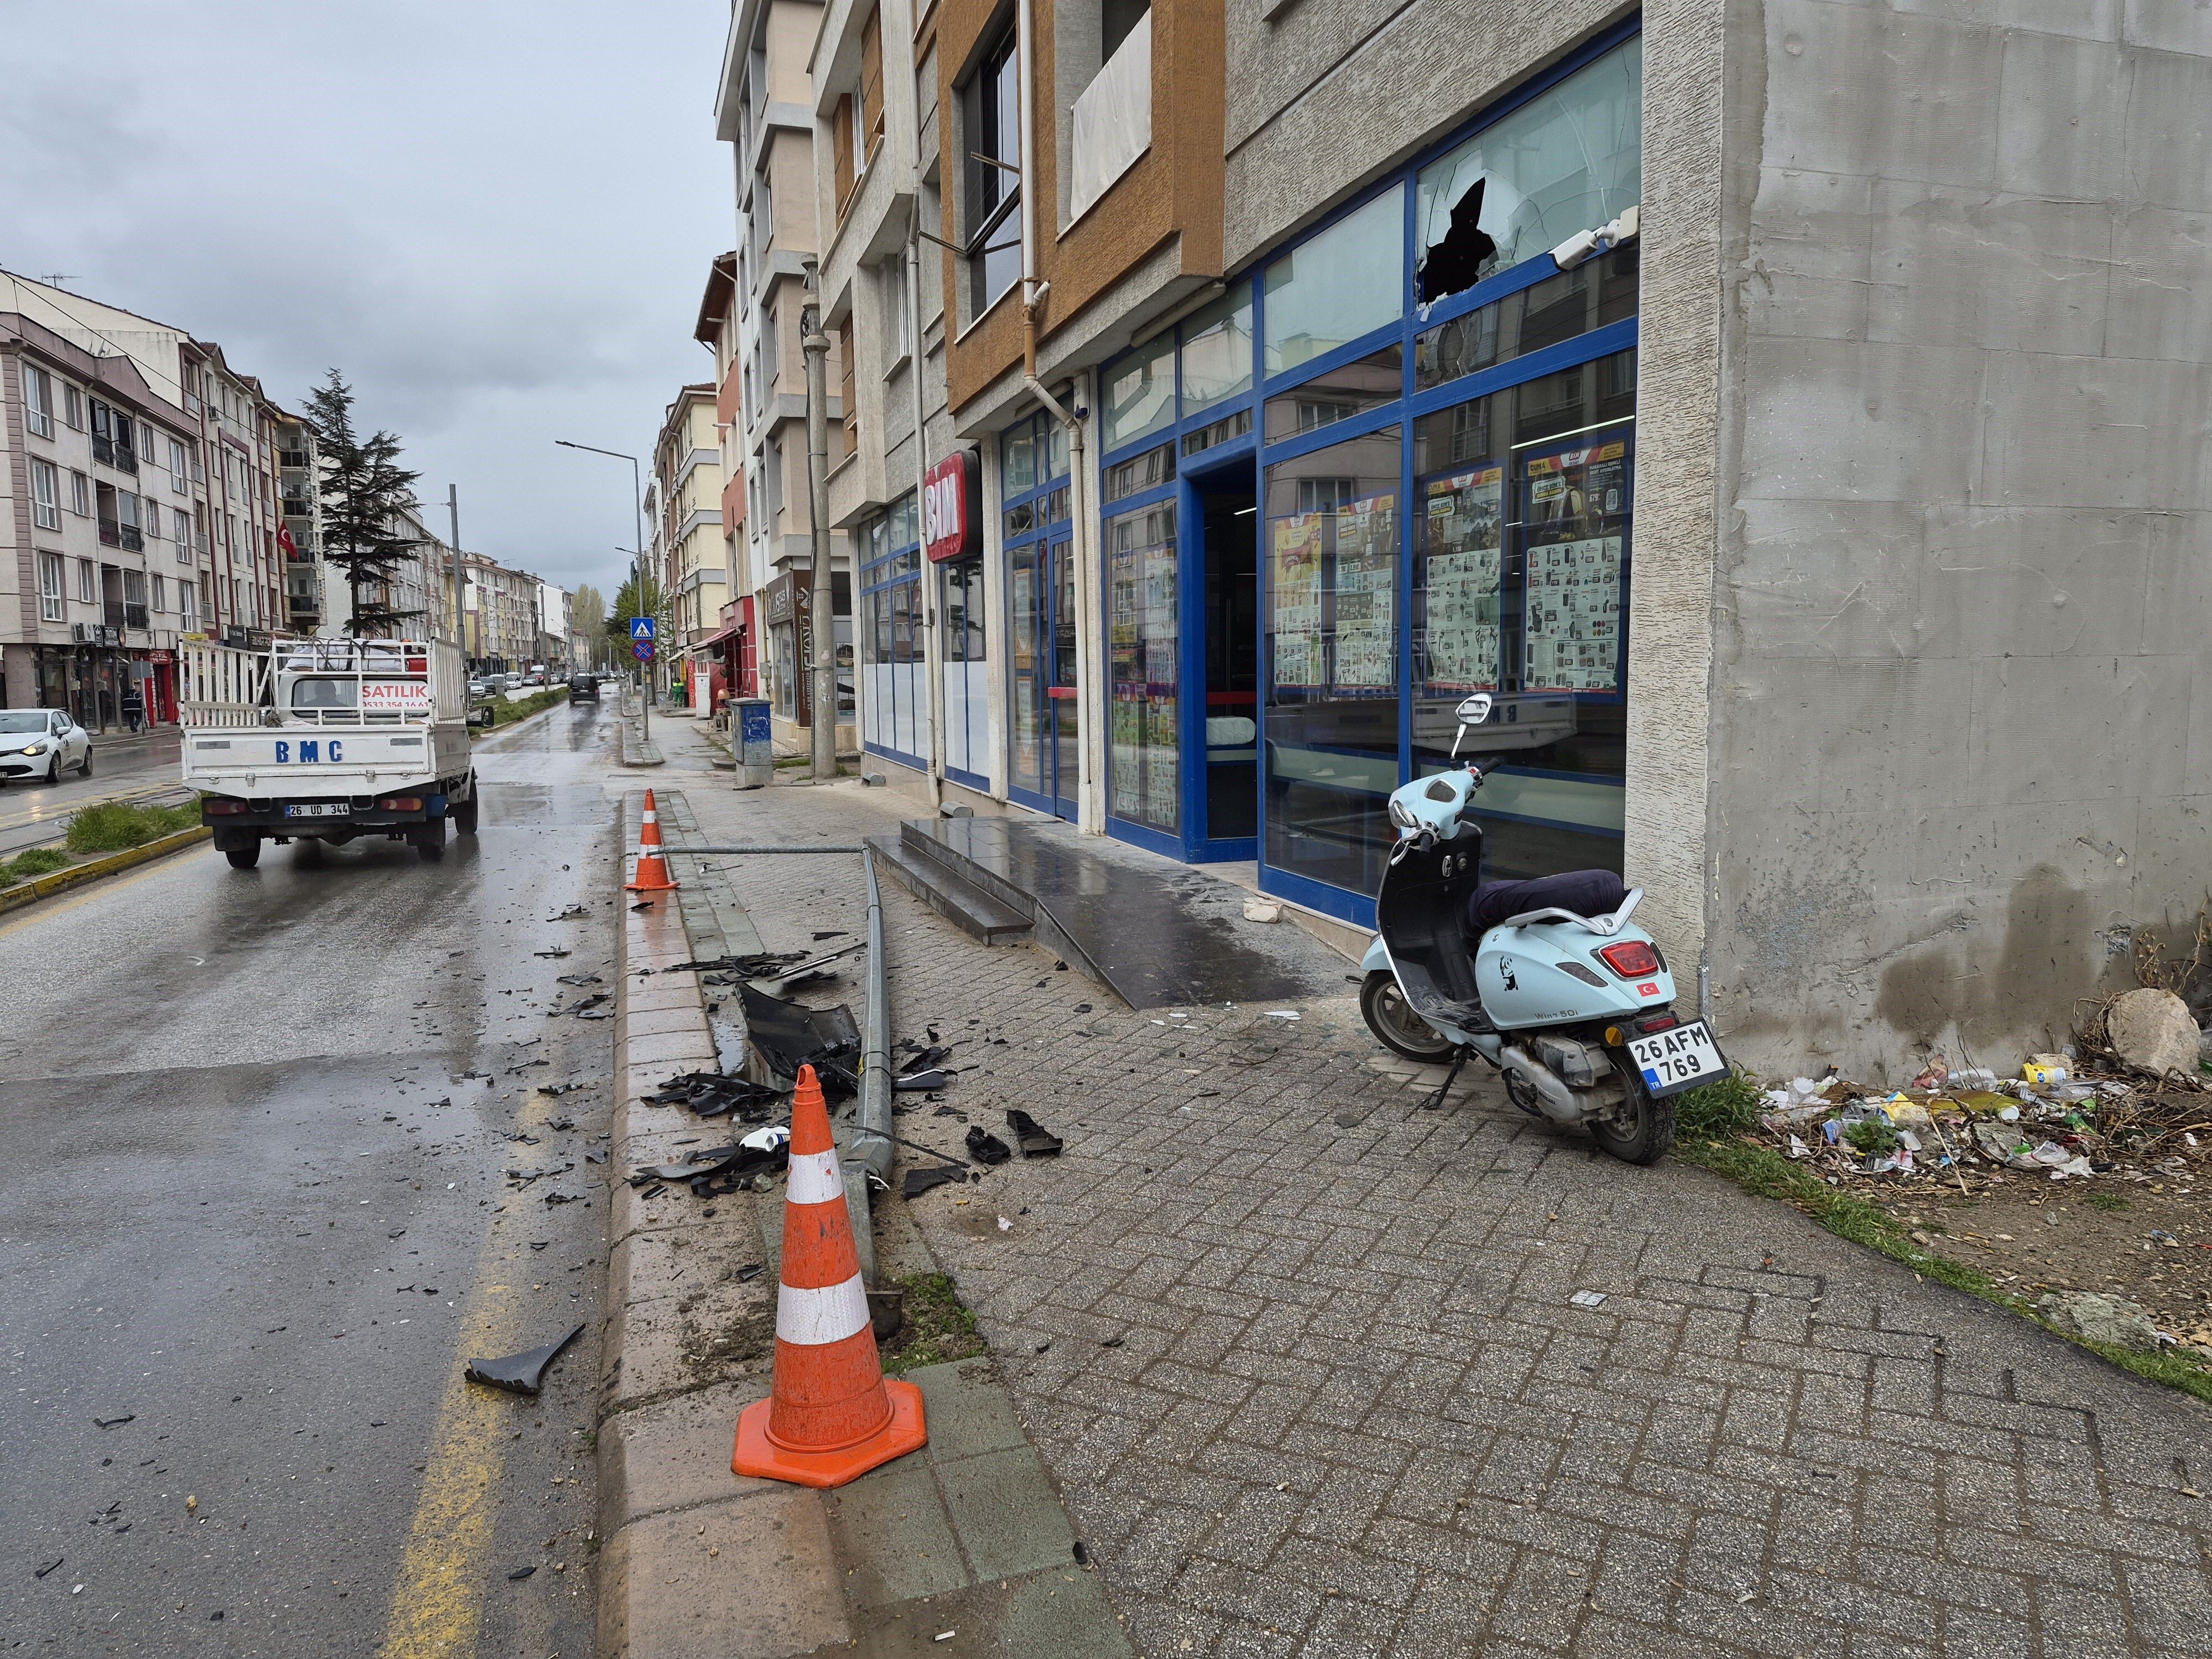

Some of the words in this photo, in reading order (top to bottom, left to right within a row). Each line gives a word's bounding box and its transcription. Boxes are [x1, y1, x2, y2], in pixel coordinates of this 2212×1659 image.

[1530, 462, 1545, 472] CUMA
[363, 686, 427, 697] SATILIK
[290, 806, 302, 816] 26
[311, 805, 322, 815] UD
[331, 805, 348, 815] 344
[1559, 1009, 1578, 1018] 50i
[1658, 1054, 1701, 1081] 769
